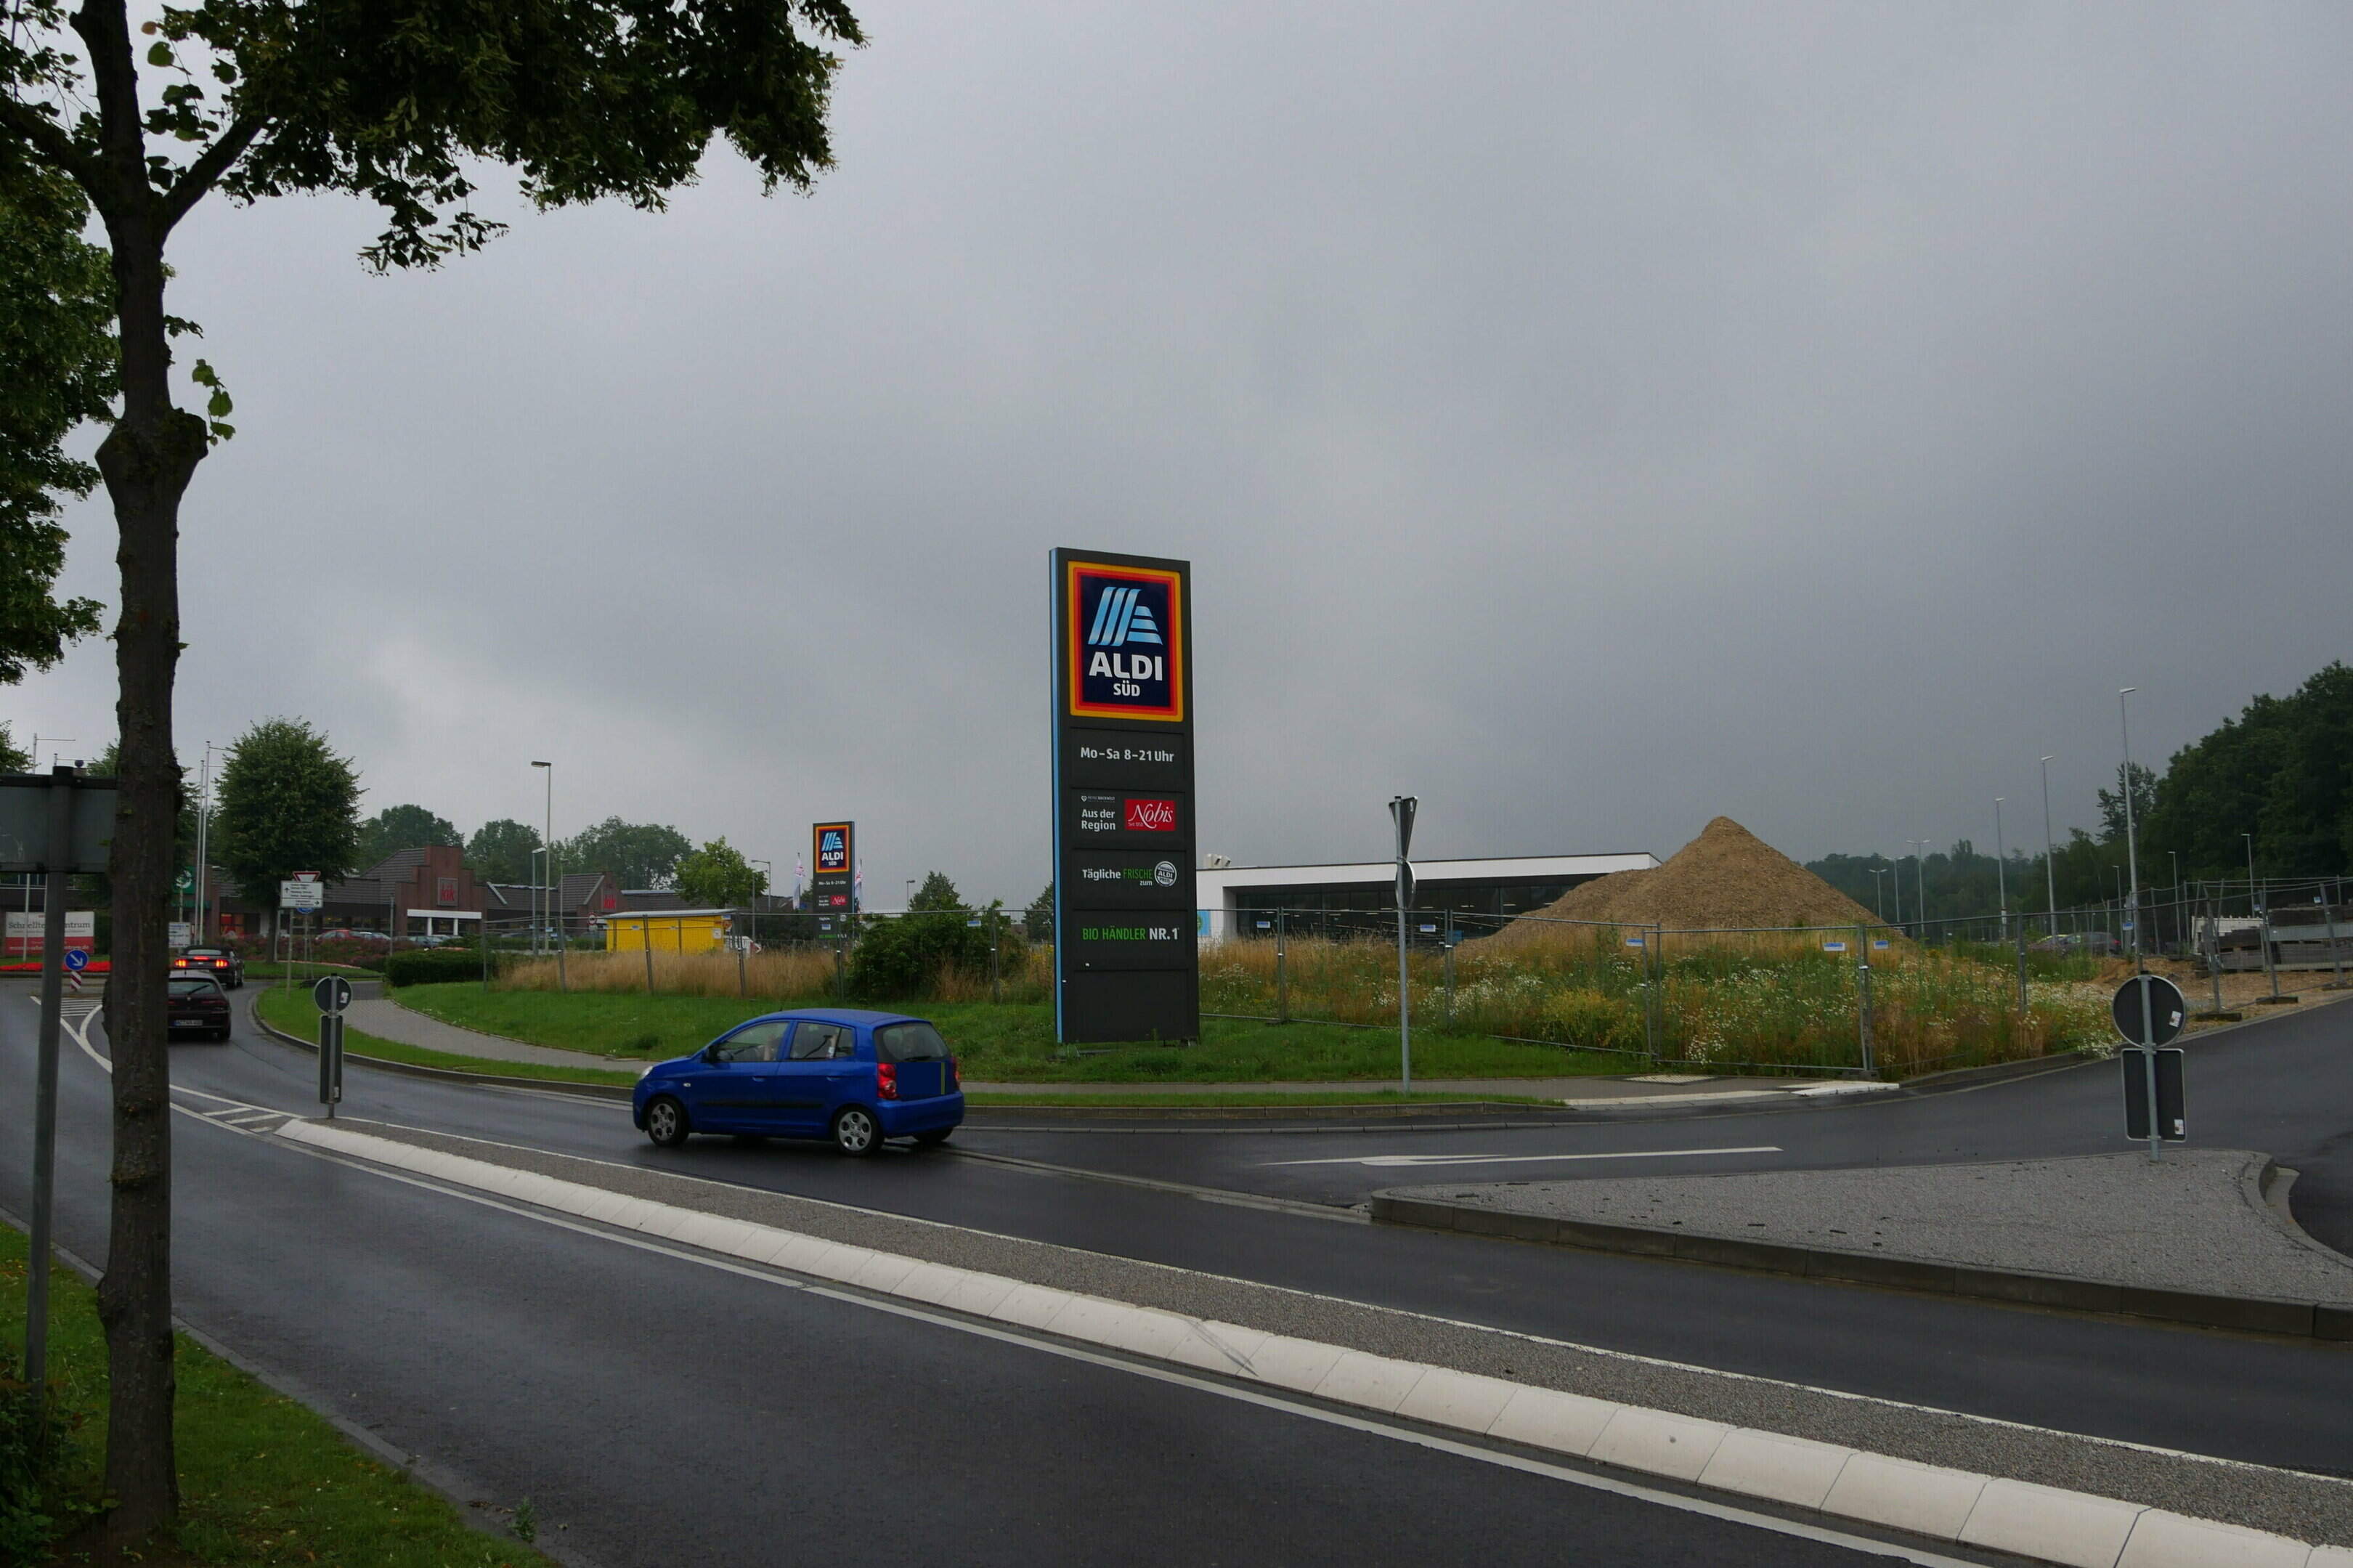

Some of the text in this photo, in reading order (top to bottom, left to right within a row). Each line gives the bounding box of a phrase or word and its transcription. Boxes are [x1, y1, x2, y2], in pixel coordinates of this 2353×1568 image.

[1089, 651, 1163, 681] ALDI
[1113, 680, 1141, 697] SÜD
[1154, 750, 1174, 762] Uhr
[1081, 808, 1115, 818] Aus der
[1128, 802, 1174, 829] Nobis
[1081, 819, 1116, 832] Region
[821, 851, 844, 861] ALDI
[1081, 868, 1121, 881] Tägliche
[1123, 869, 1153, 880] FRISCHE
[1158, 870, 1173, 879] ALDI
[1082, 927, 1099, 941] BIO
[1102, 925, 1146, 941] HÄNDLER
